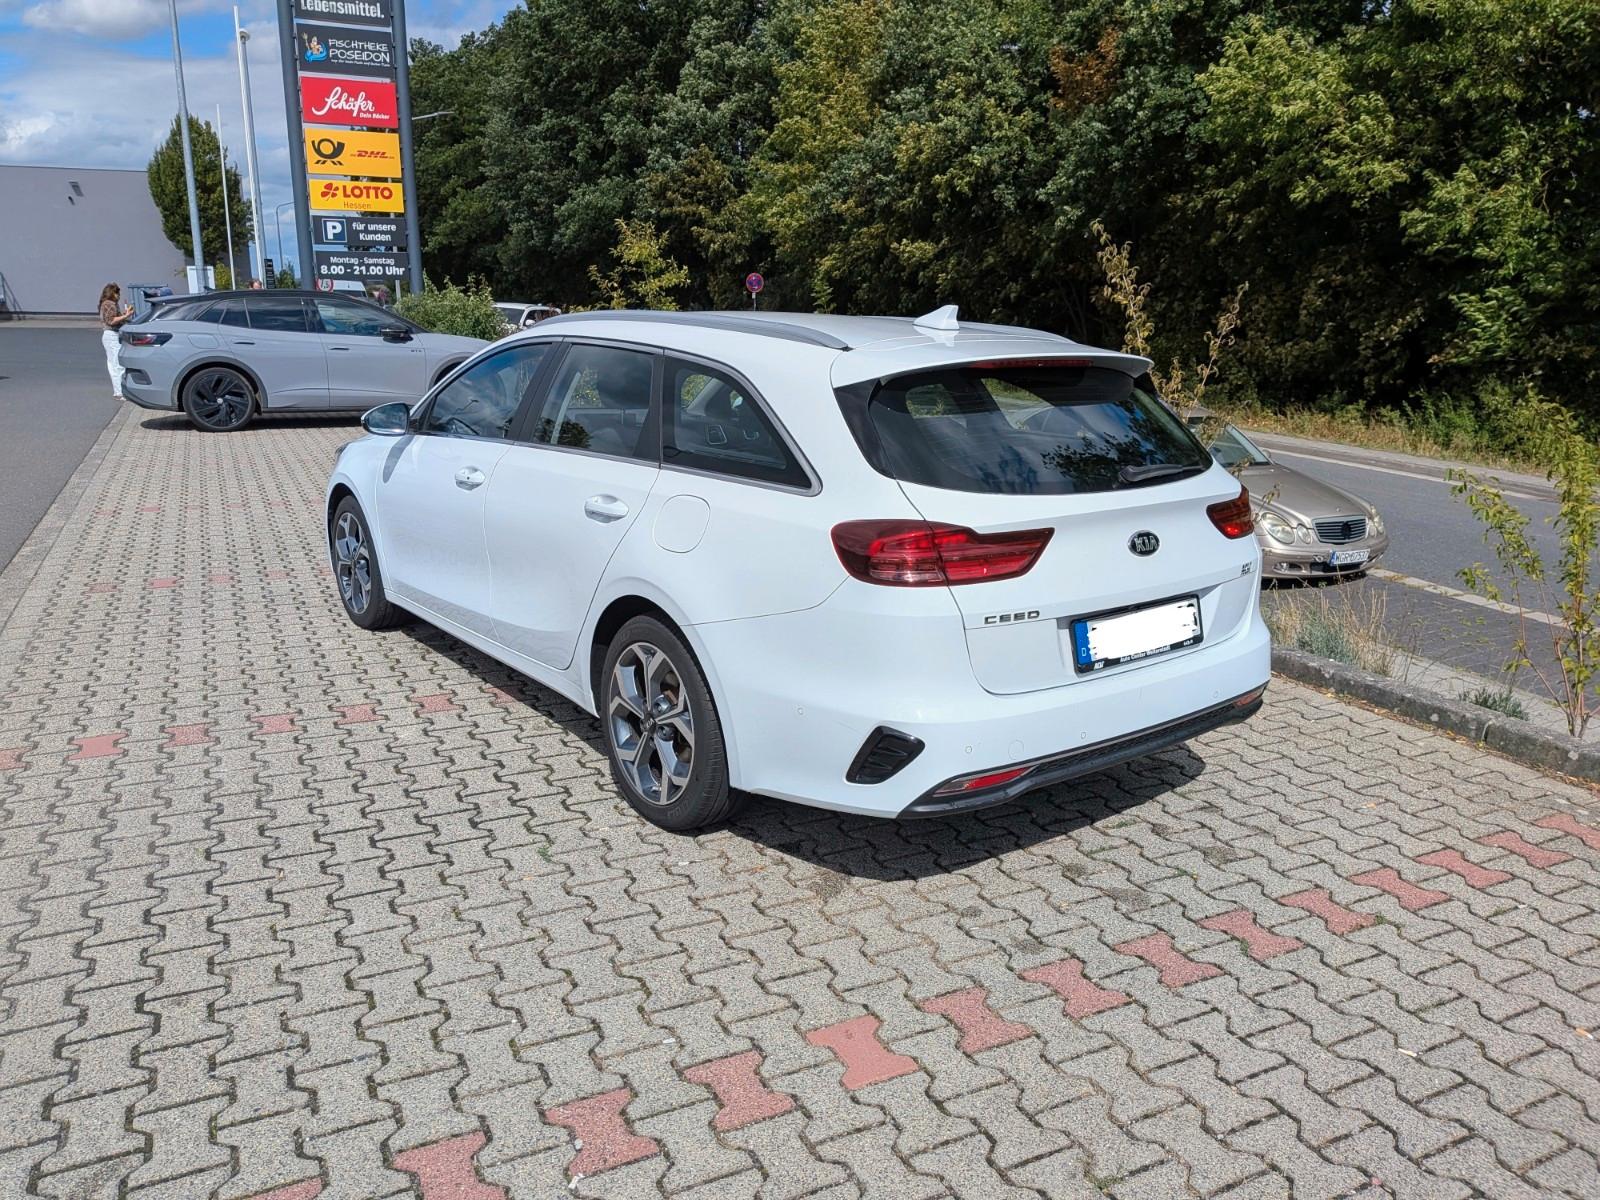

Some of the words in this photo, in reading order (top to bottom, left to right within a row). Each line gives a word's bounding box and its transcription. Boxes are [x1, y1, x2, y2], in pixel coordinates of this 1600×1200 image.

[300, 0, 385, 18] Lebensmittel.
[328, 39, 389, 51] FISCHTHEKE
[329, 48, 390, 63] POSEIDON
[311, 86, 375, 117] Schäfer
[356, 150, 389, 159] DHL
[342, 184, 394, 200] LOTTO
[343, 201, 372, 209] Hessen
[326, 221, 342, 239] P
[352, 222, 365, 231] für
[367, 222, 397, 231] unsere
[359, 233, 392, 241] Kunden
[330, 256, 359, 264] Montag
[364, 257, 395, 265] Samstag
[320, 265, 345, 275] 8.00
[354, 266, 383, 275] 21.00
[385, 266, 405, 275] Uhr
[1134, 535, 1158, 552] KIA
[984, 610, 1040, 625] CEED
